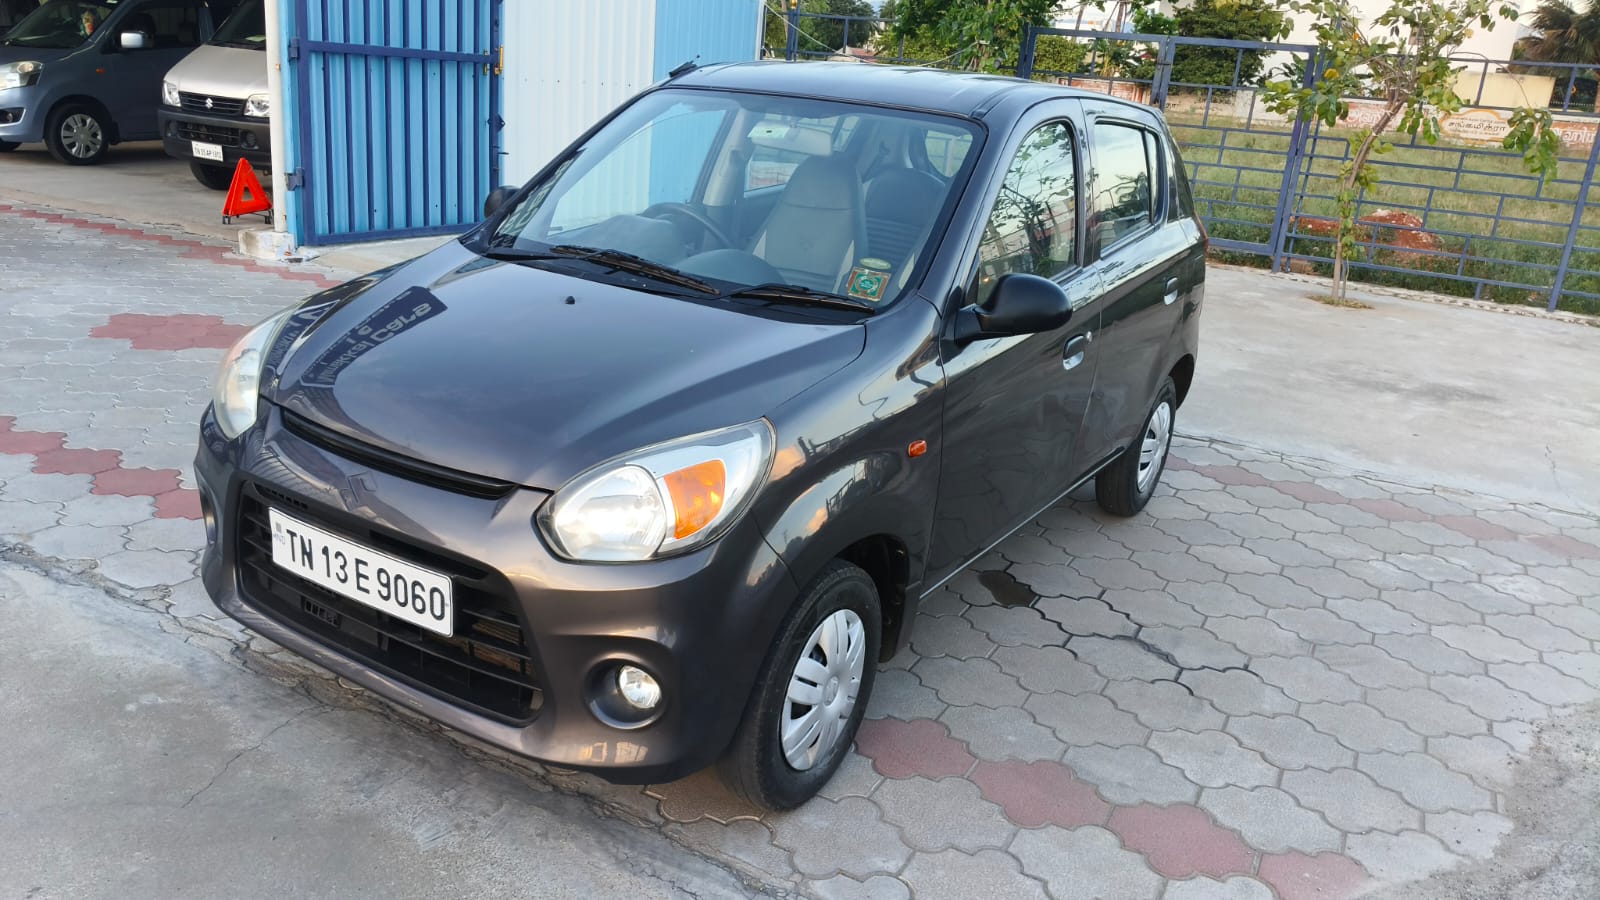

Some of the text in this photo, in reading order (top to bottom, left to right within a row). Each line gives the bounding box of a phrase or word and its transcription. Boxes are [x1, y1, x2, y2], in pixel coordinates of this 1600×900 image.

[286, 529, 446, 621] TN 13 E 9060
